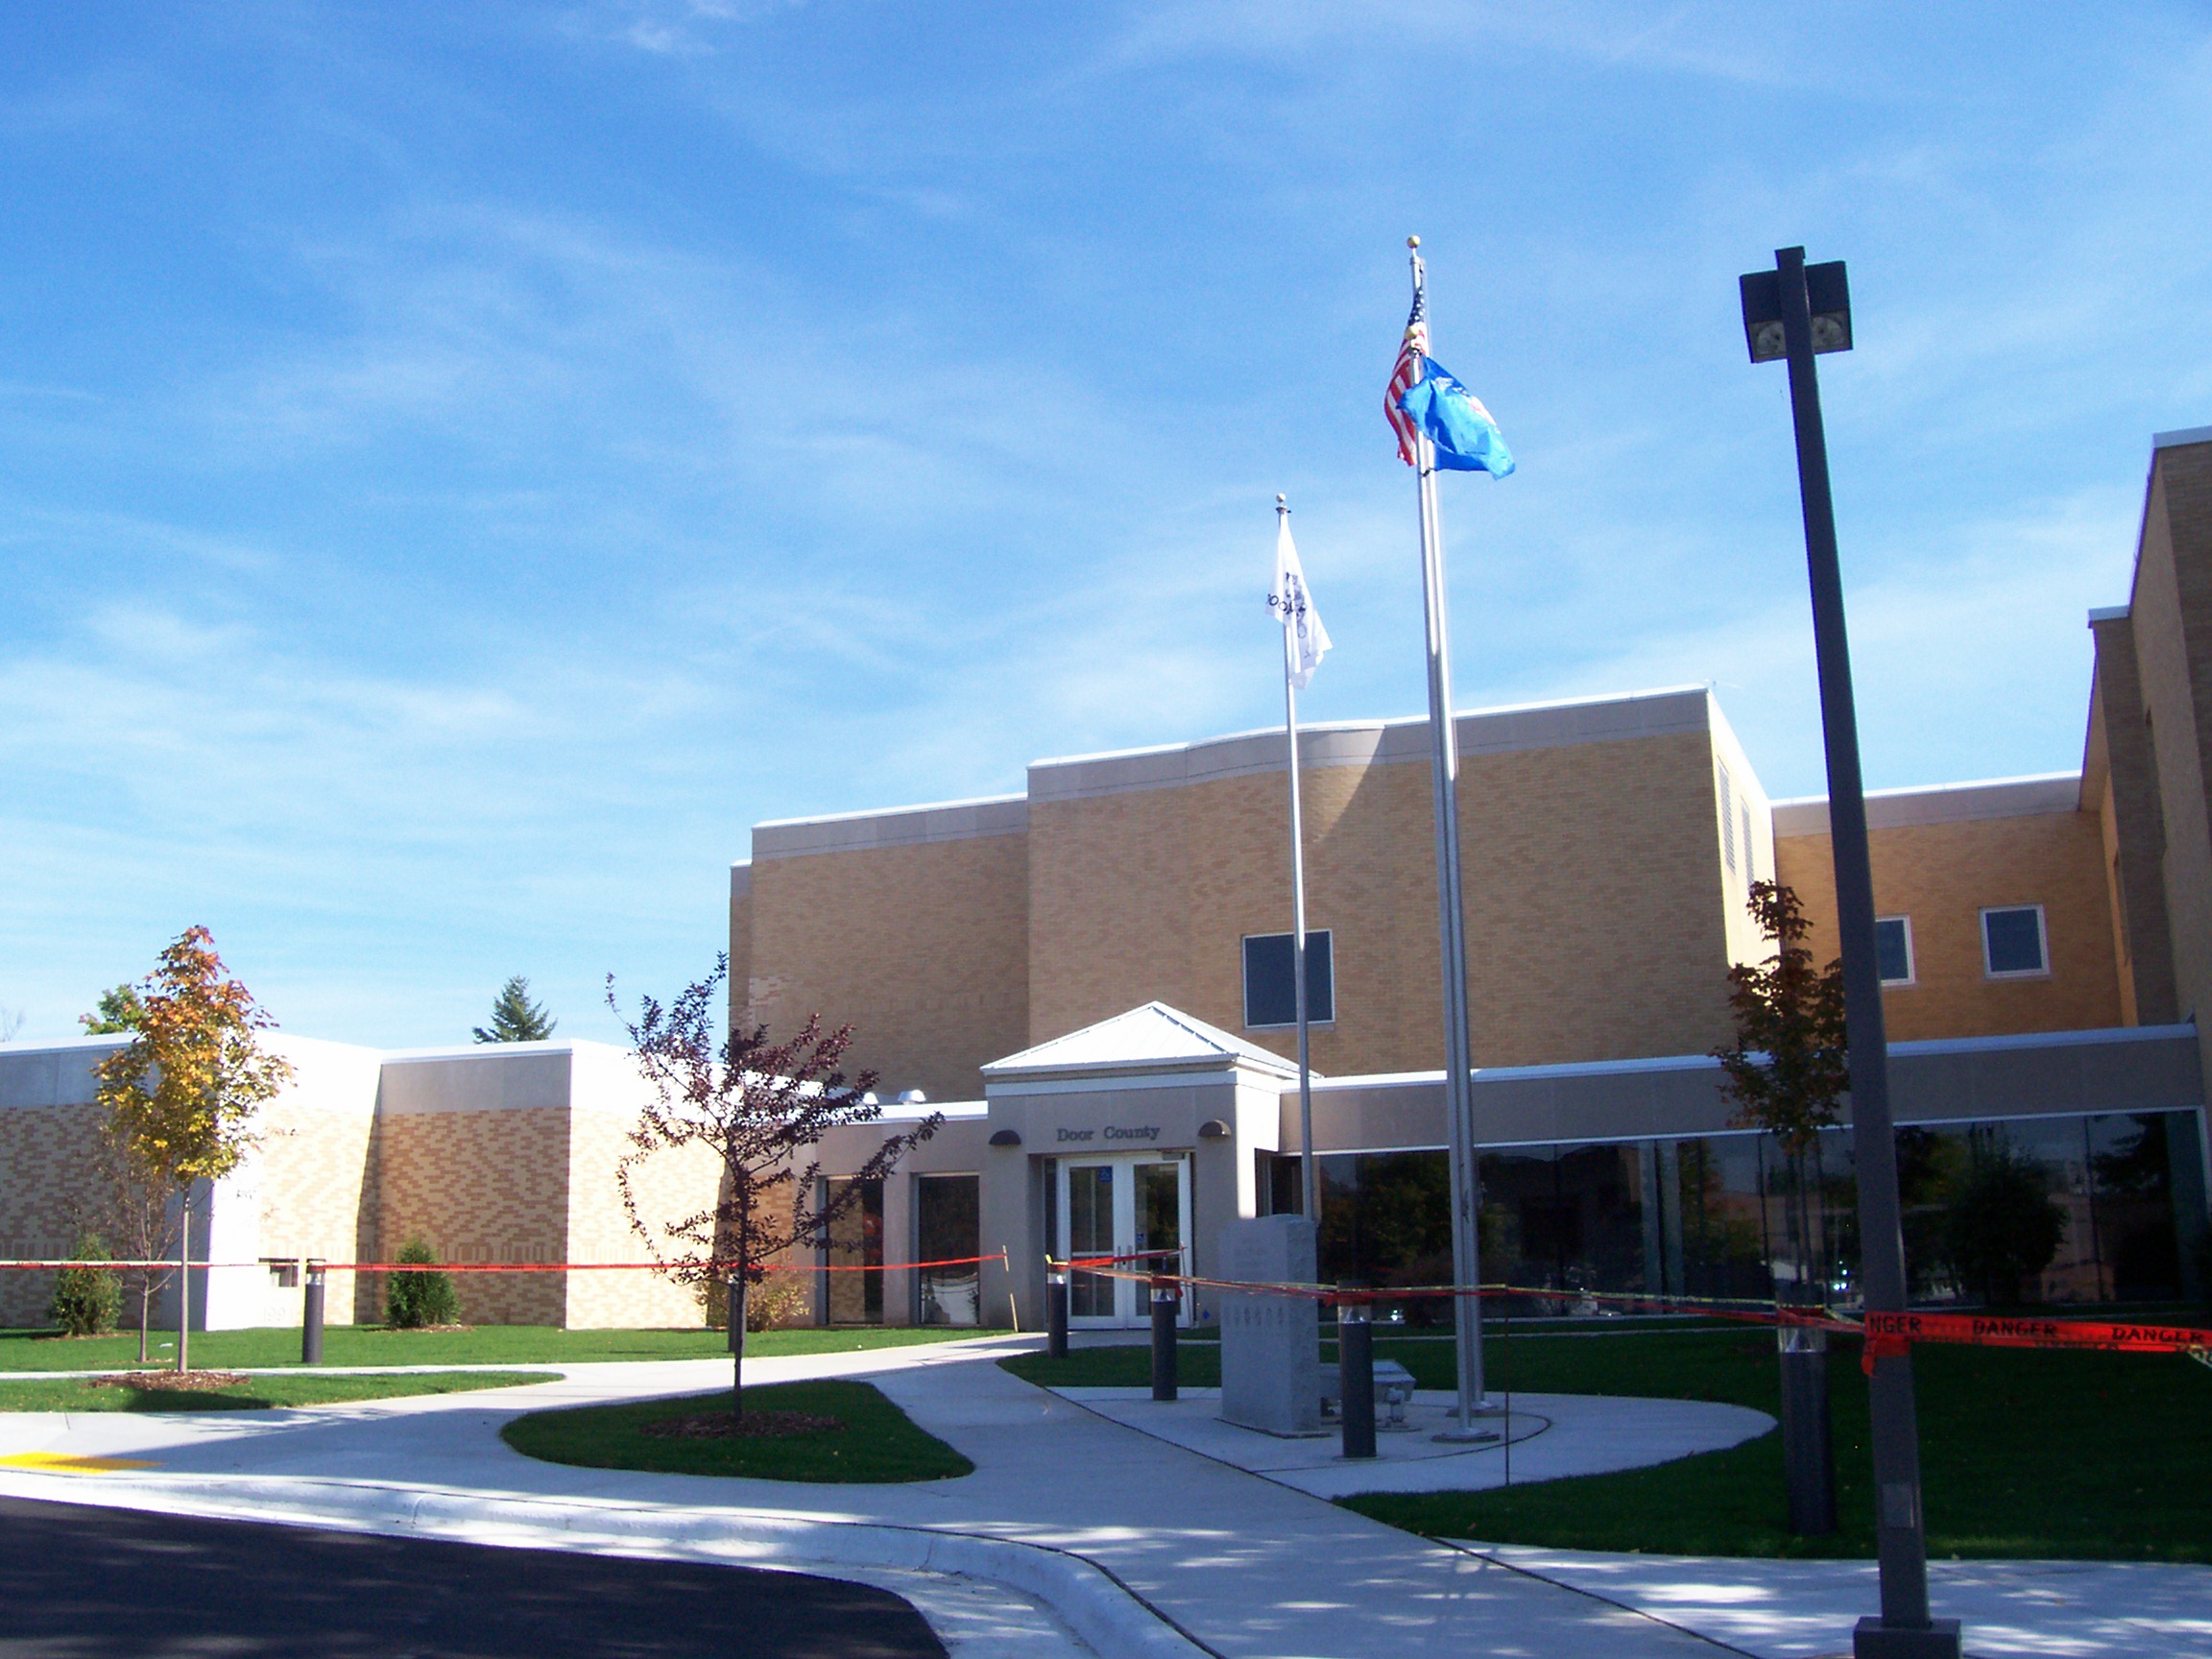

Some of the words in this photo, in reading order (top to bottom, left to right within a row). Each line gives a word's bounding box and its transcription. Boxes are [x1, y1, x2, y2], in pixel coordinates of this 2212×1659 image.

[1057, 1128, 1094, 1142] Door
[1104, 1125, 1161, 1141] County
[1869, 1315, 1922, 1334] NGER
[1973, 1319, 2057, 1335] DANGER
[2112, 1327, 2204, 1343] DANGER
